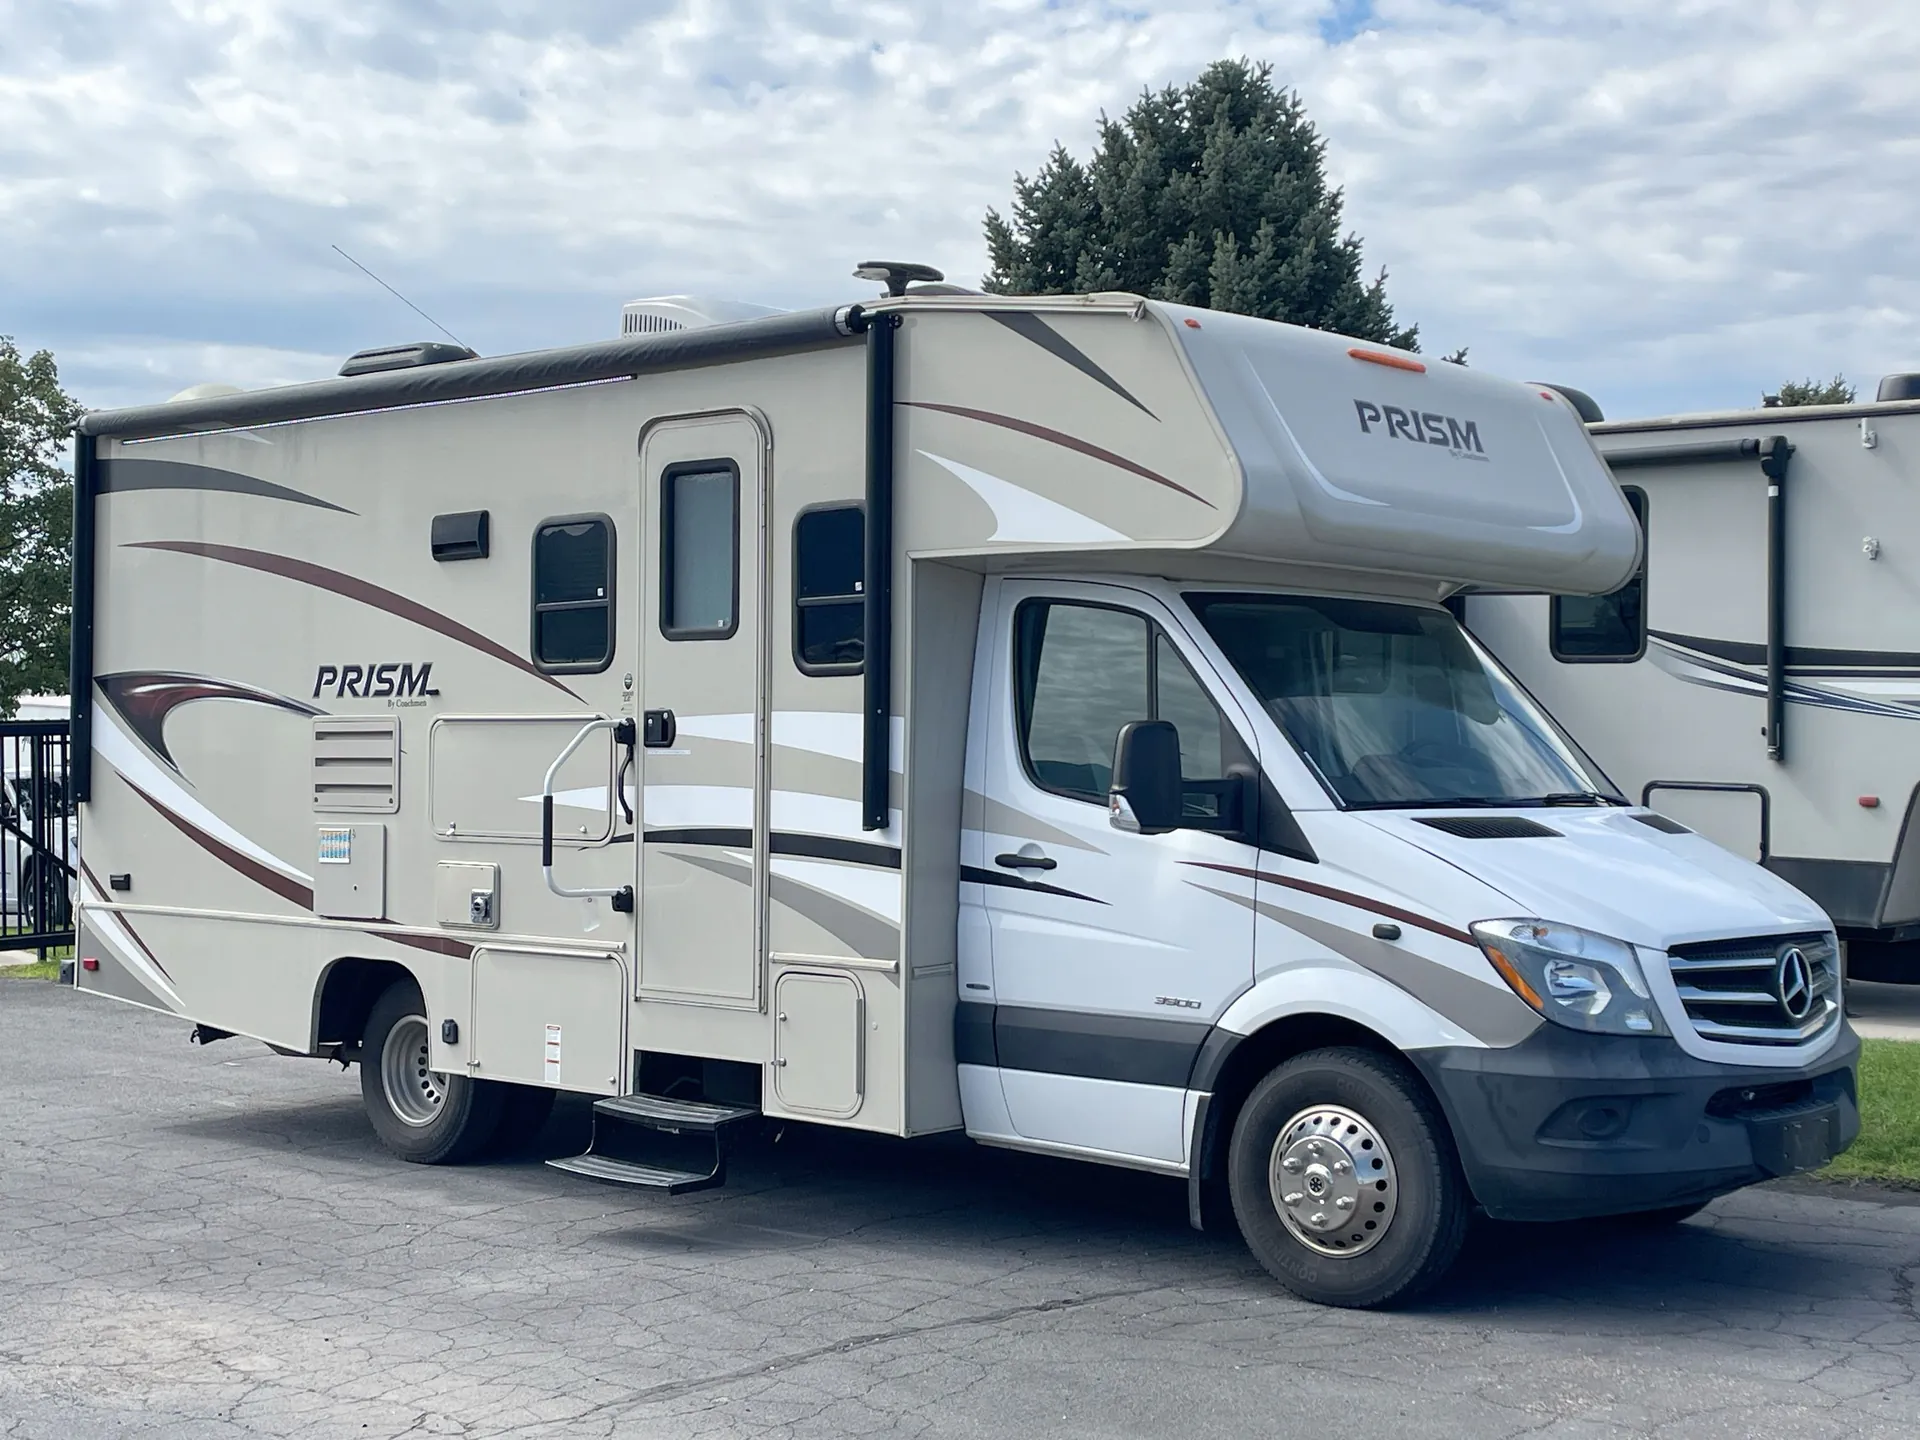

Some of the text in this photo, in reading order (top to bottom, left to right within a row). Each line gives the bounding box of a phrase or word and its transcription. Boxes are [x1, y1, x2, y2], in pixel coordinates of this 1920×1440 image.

[1353, 398, 1485, 453] PRISM
[312, 662, 433, 698] PRISM
[387, 699, 395, 710] By
[1154, 996, 1201, 1010] 3500
